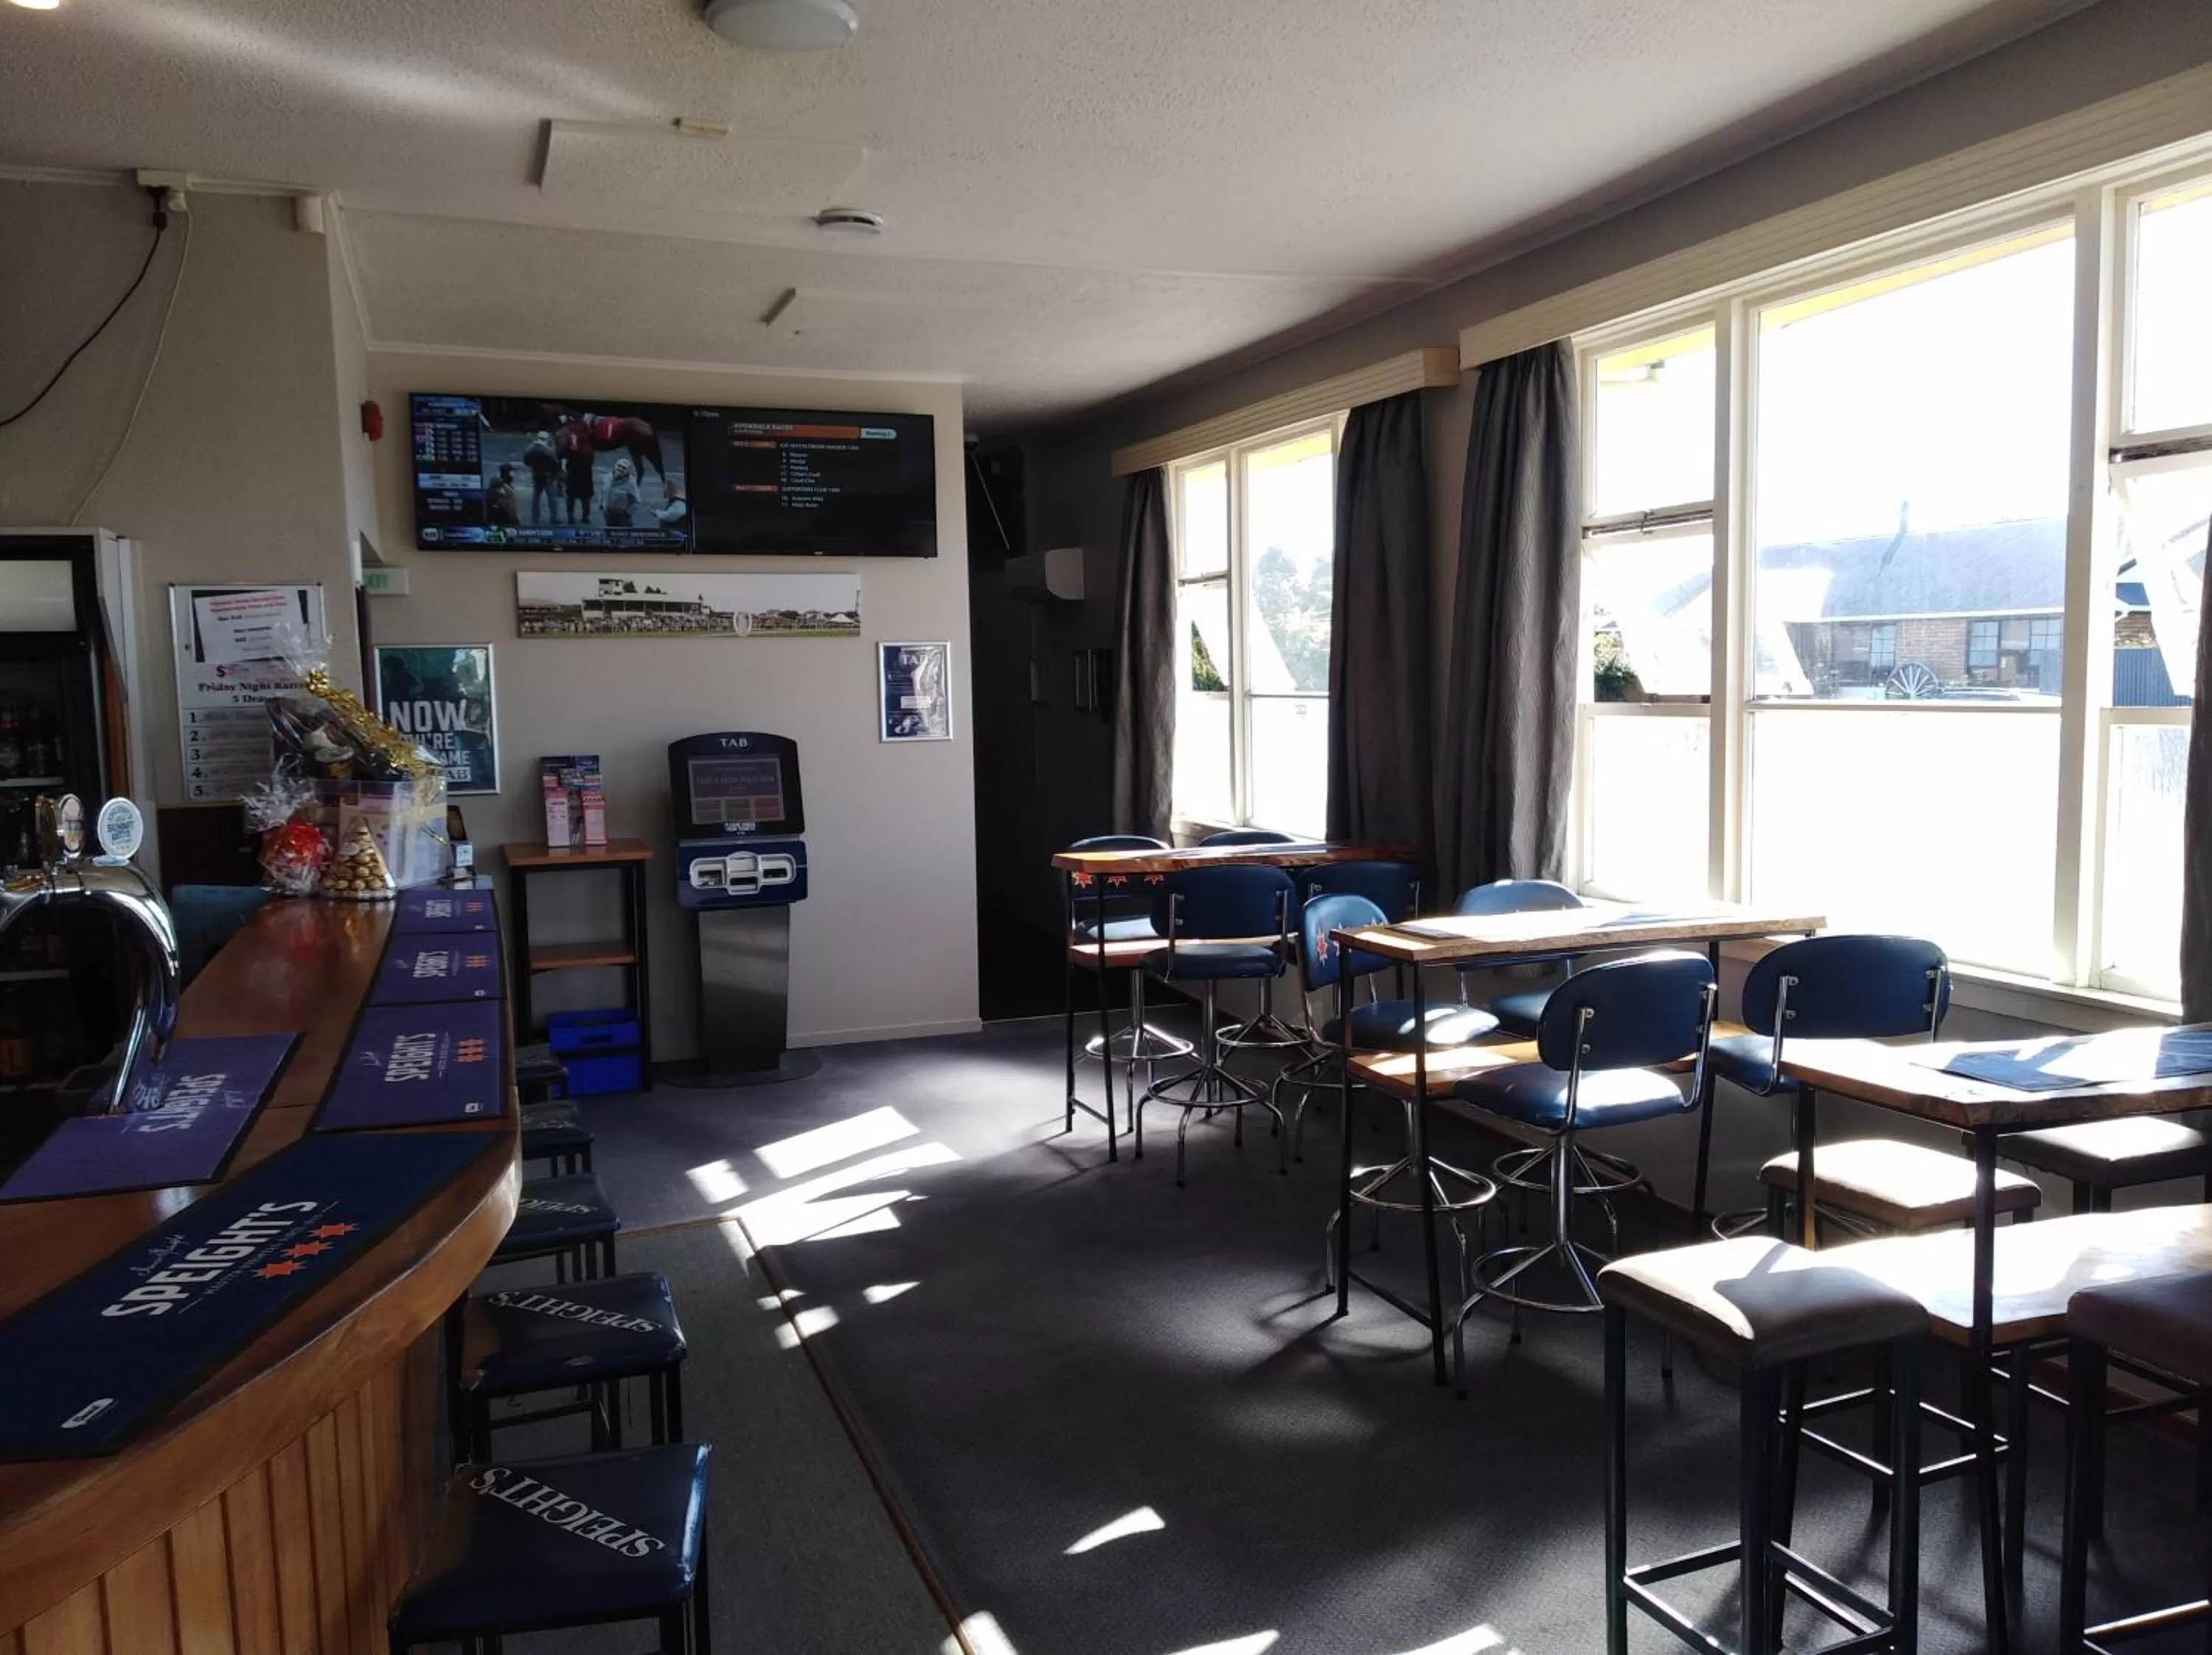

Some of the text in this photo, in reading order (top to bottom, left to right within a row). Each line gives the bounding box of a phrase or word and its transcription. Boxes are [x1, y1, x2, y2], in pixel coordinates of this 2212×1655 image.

[198, 683, 237, 693] Friday
[239, 683, 271, 693] Night
[389, 698, 467, 732] NOW
[718, 737, 748, 748] TAB
[100, 1200, 319, 1318] SPEIGHT'S
[487, 1290, 664, 1334] SPEIGHT'S
[470, 1467, 666, 1558] SPEIGHT'S
